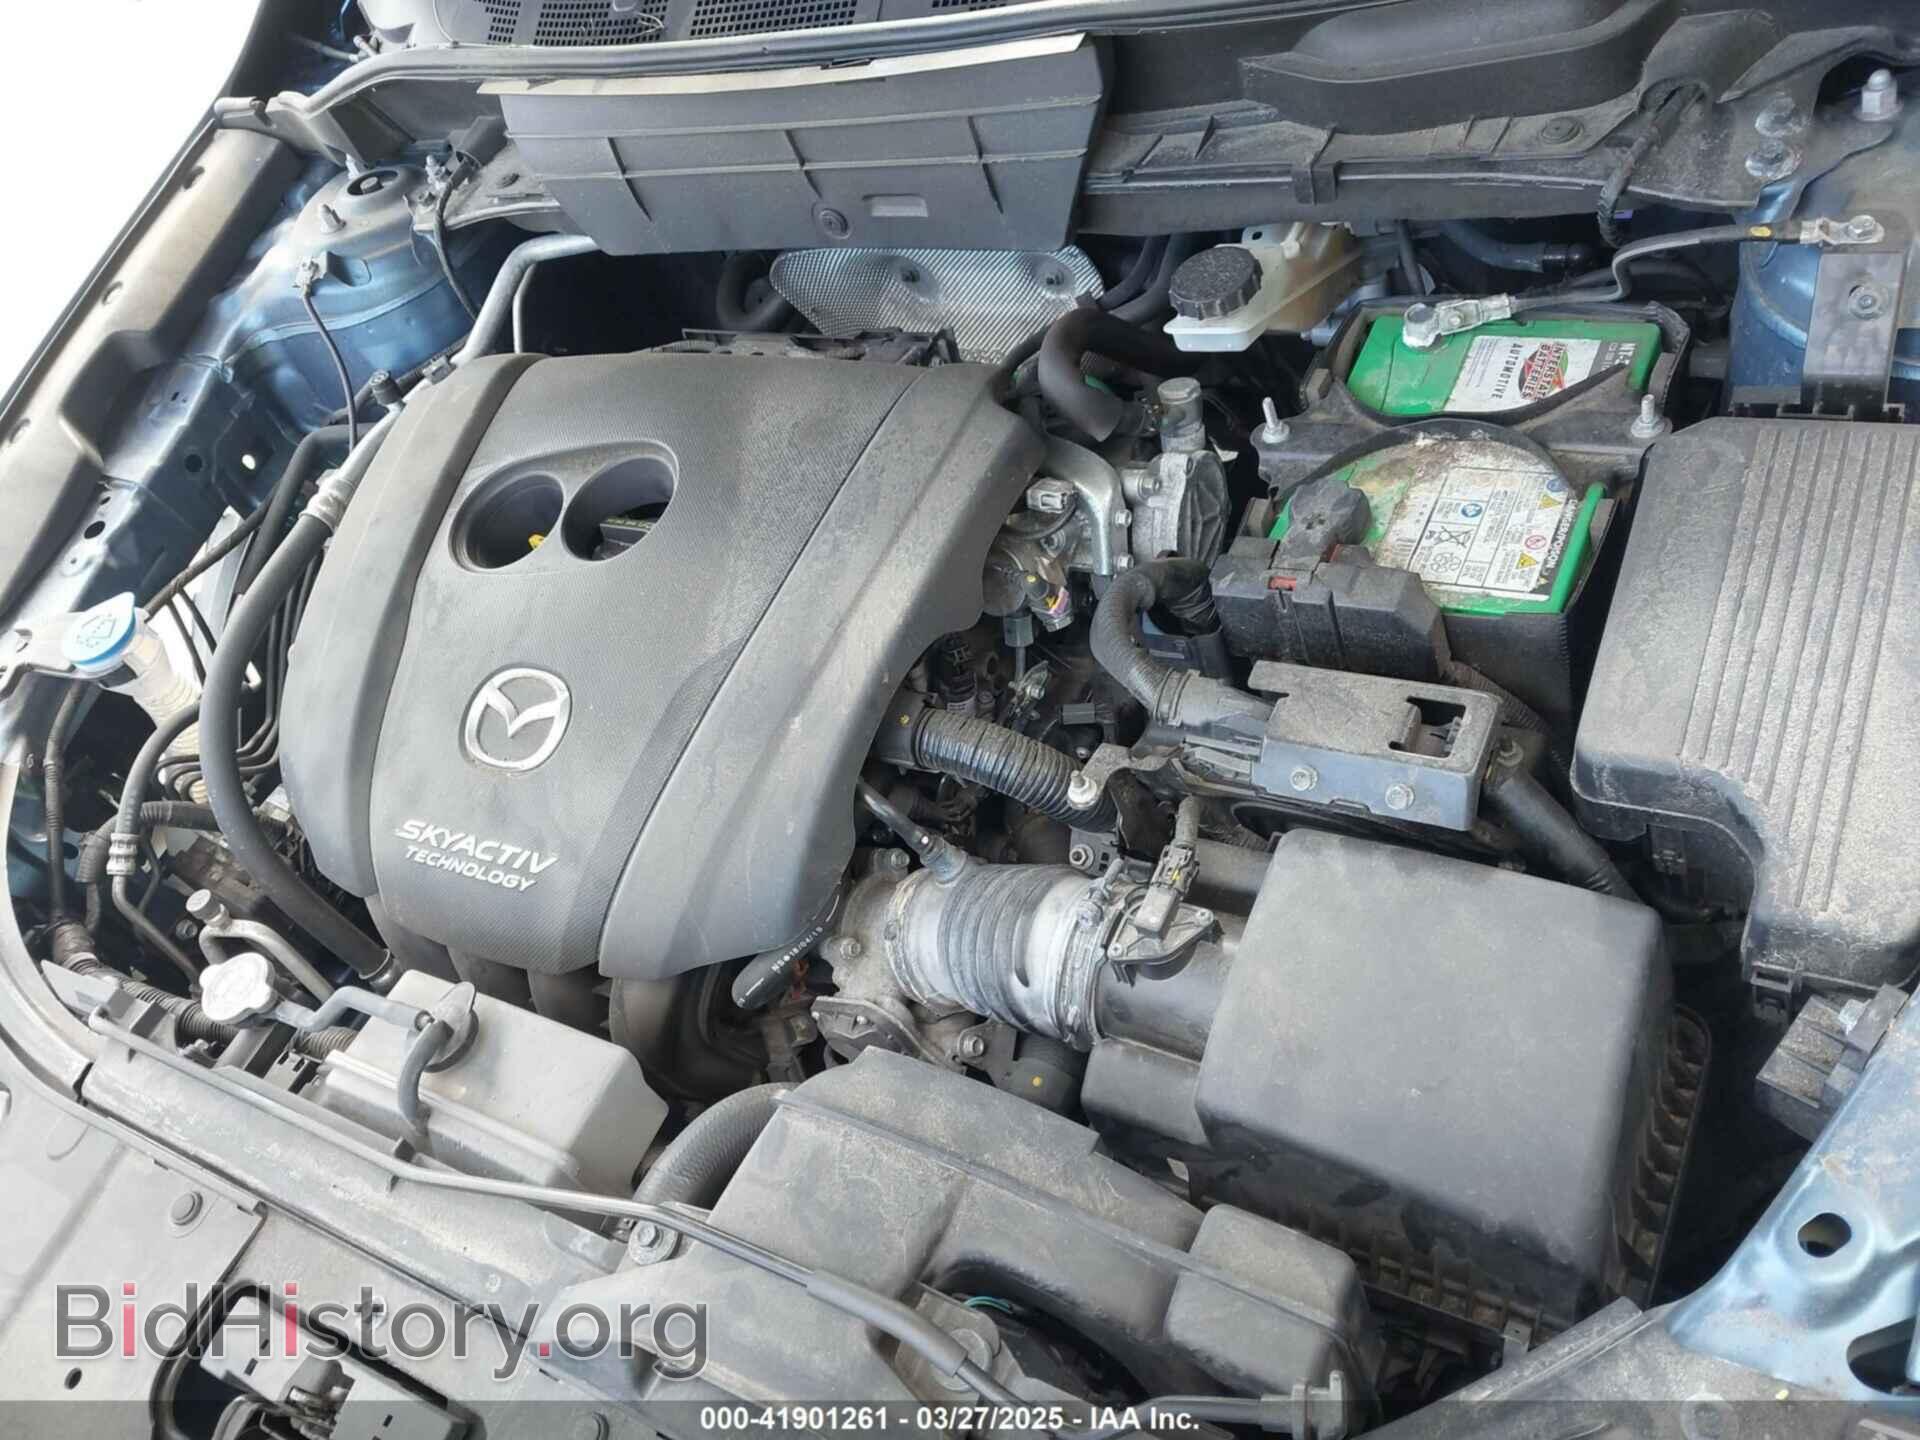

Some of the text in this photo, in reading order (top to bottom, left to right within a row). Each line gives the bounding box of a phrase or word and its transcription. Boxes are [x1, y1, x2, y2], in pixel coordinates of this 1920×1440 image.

[1491, 343, 1523, 399] AUTOMOTIVE
[1520, 343, 1552, 400] BATTERIES
[1535, 342, 1569, 401] INTERSTAT
[395, 819, 558, 874] SKYACTIV
[405, 845, 537, 891] TECHNOLOGY
